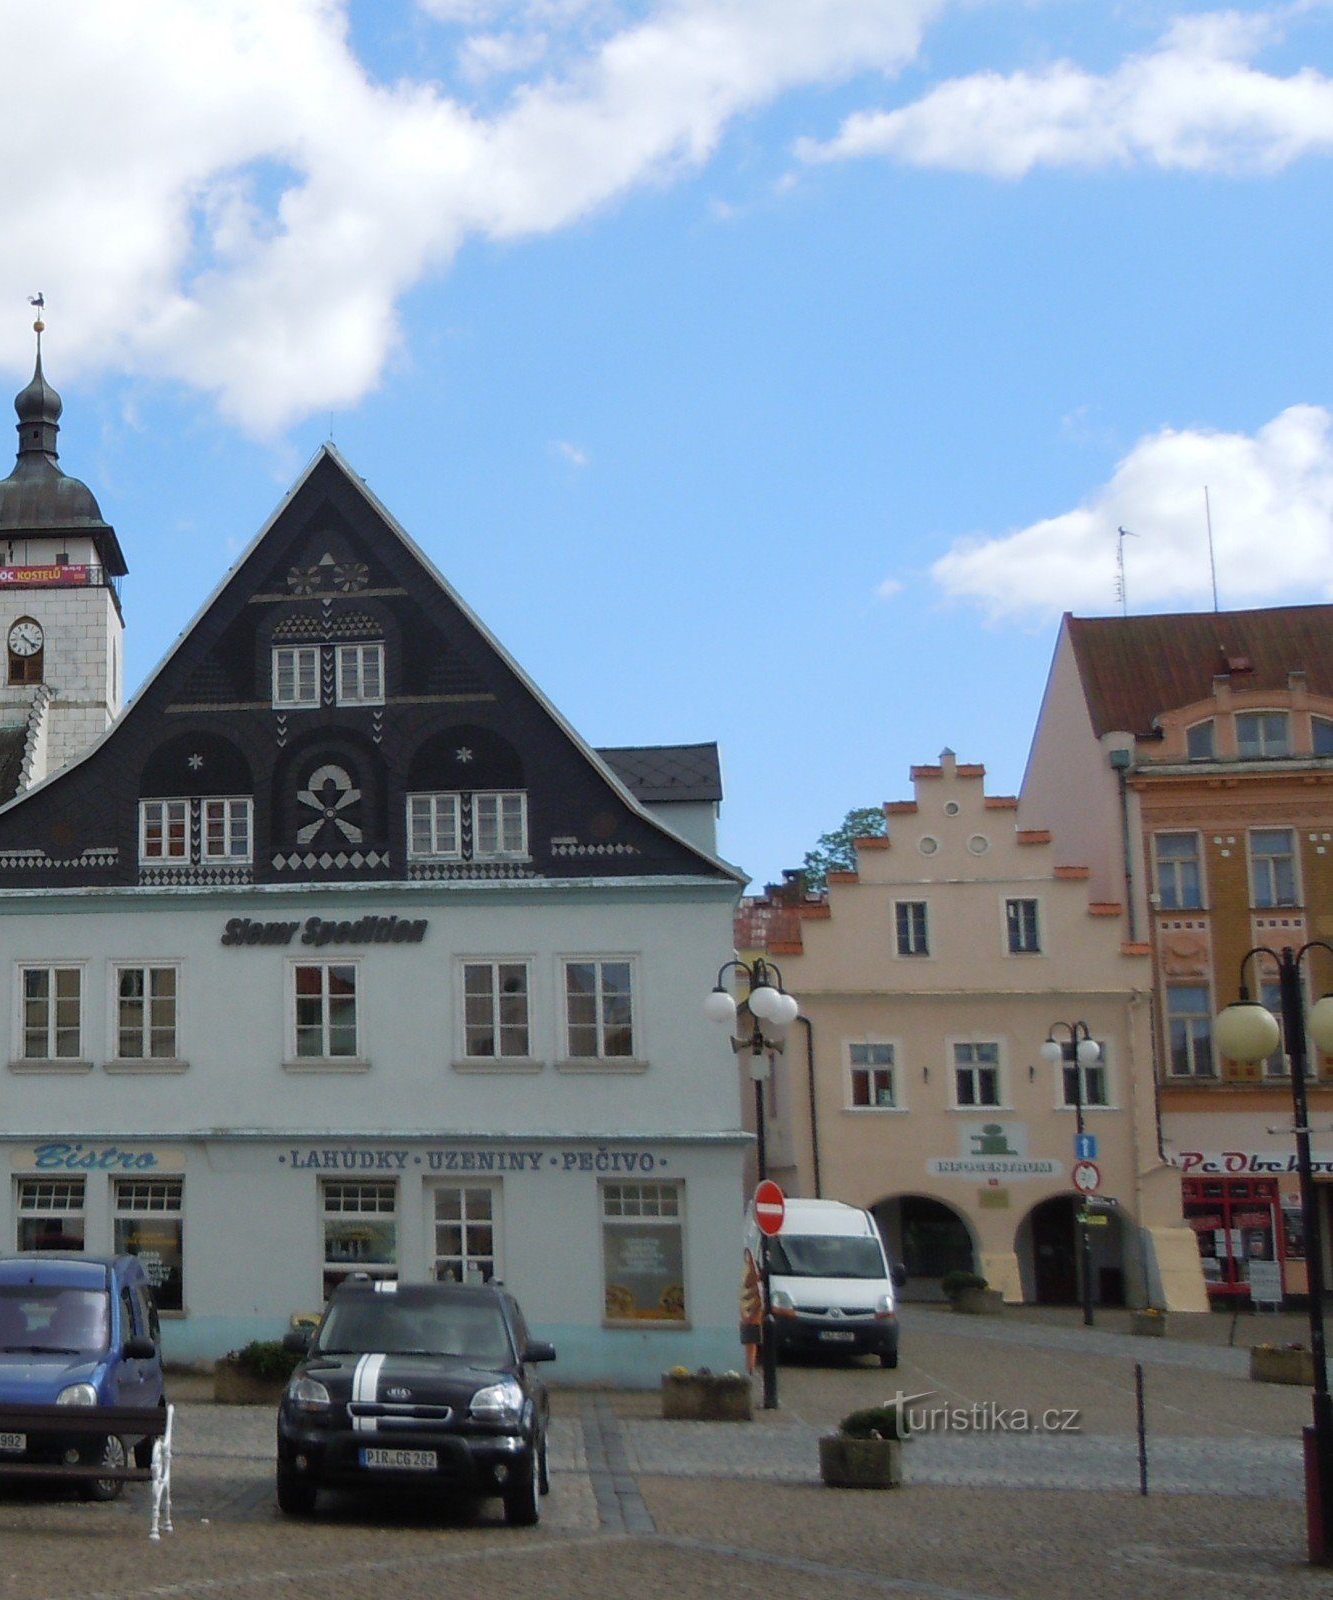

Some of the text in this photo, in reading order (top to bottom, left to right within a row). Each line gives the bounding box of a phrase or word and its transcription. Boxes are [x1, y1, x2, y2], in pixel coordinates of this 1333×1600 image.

[17, 567, 61, 580] KOSTELŮ
[301, 915, 429, 947] Spedition
[33, 1143, 158, 1169] Bistro
[426, 1151, 544, 1171] UZENINY
[561, 1146, 654, 1171] PEČIVO
[368, 1450, 389, 1464] PIR
